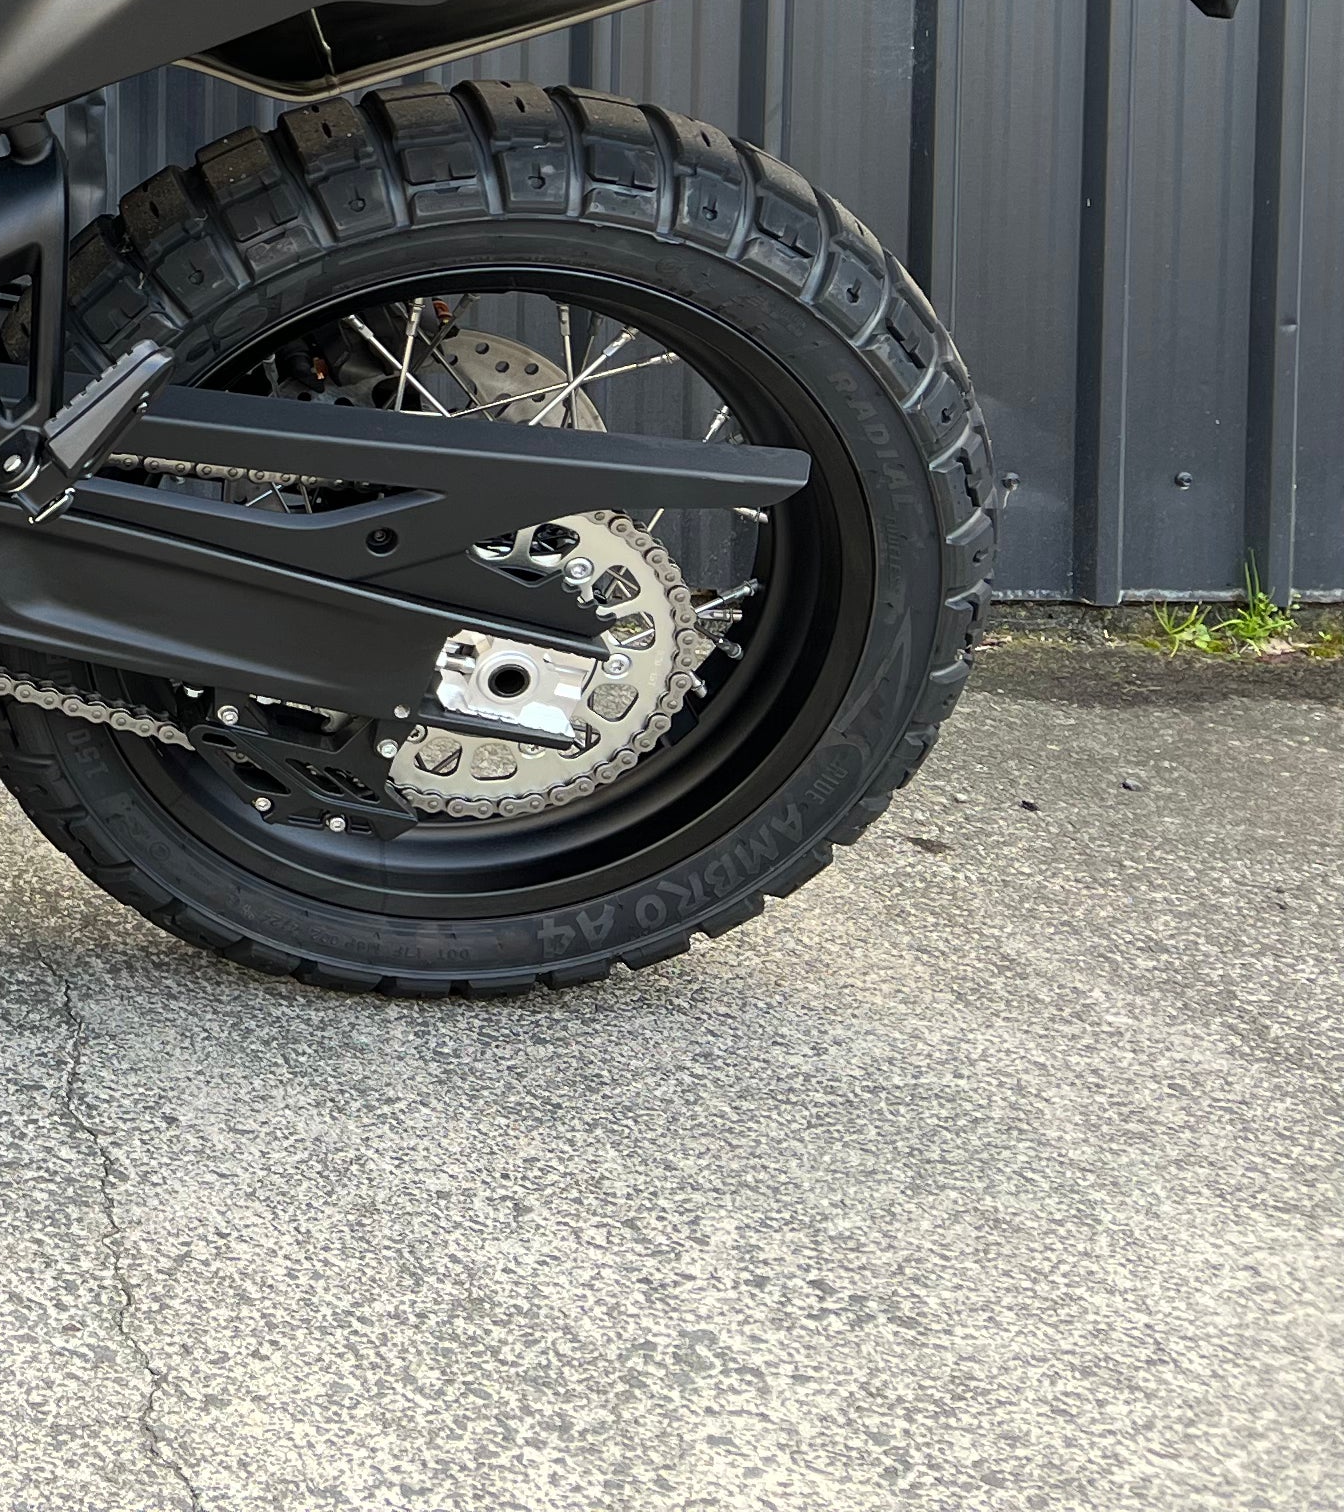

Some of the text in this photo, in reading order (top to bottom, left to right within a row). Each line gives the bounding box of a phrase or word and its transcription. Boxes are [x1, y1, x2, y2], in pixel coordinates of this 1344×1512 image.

[826, 371, 915, 511] RADIAL
[536, 903, 613, 960] A4
[634, 801, 806, 932] AMBRO
